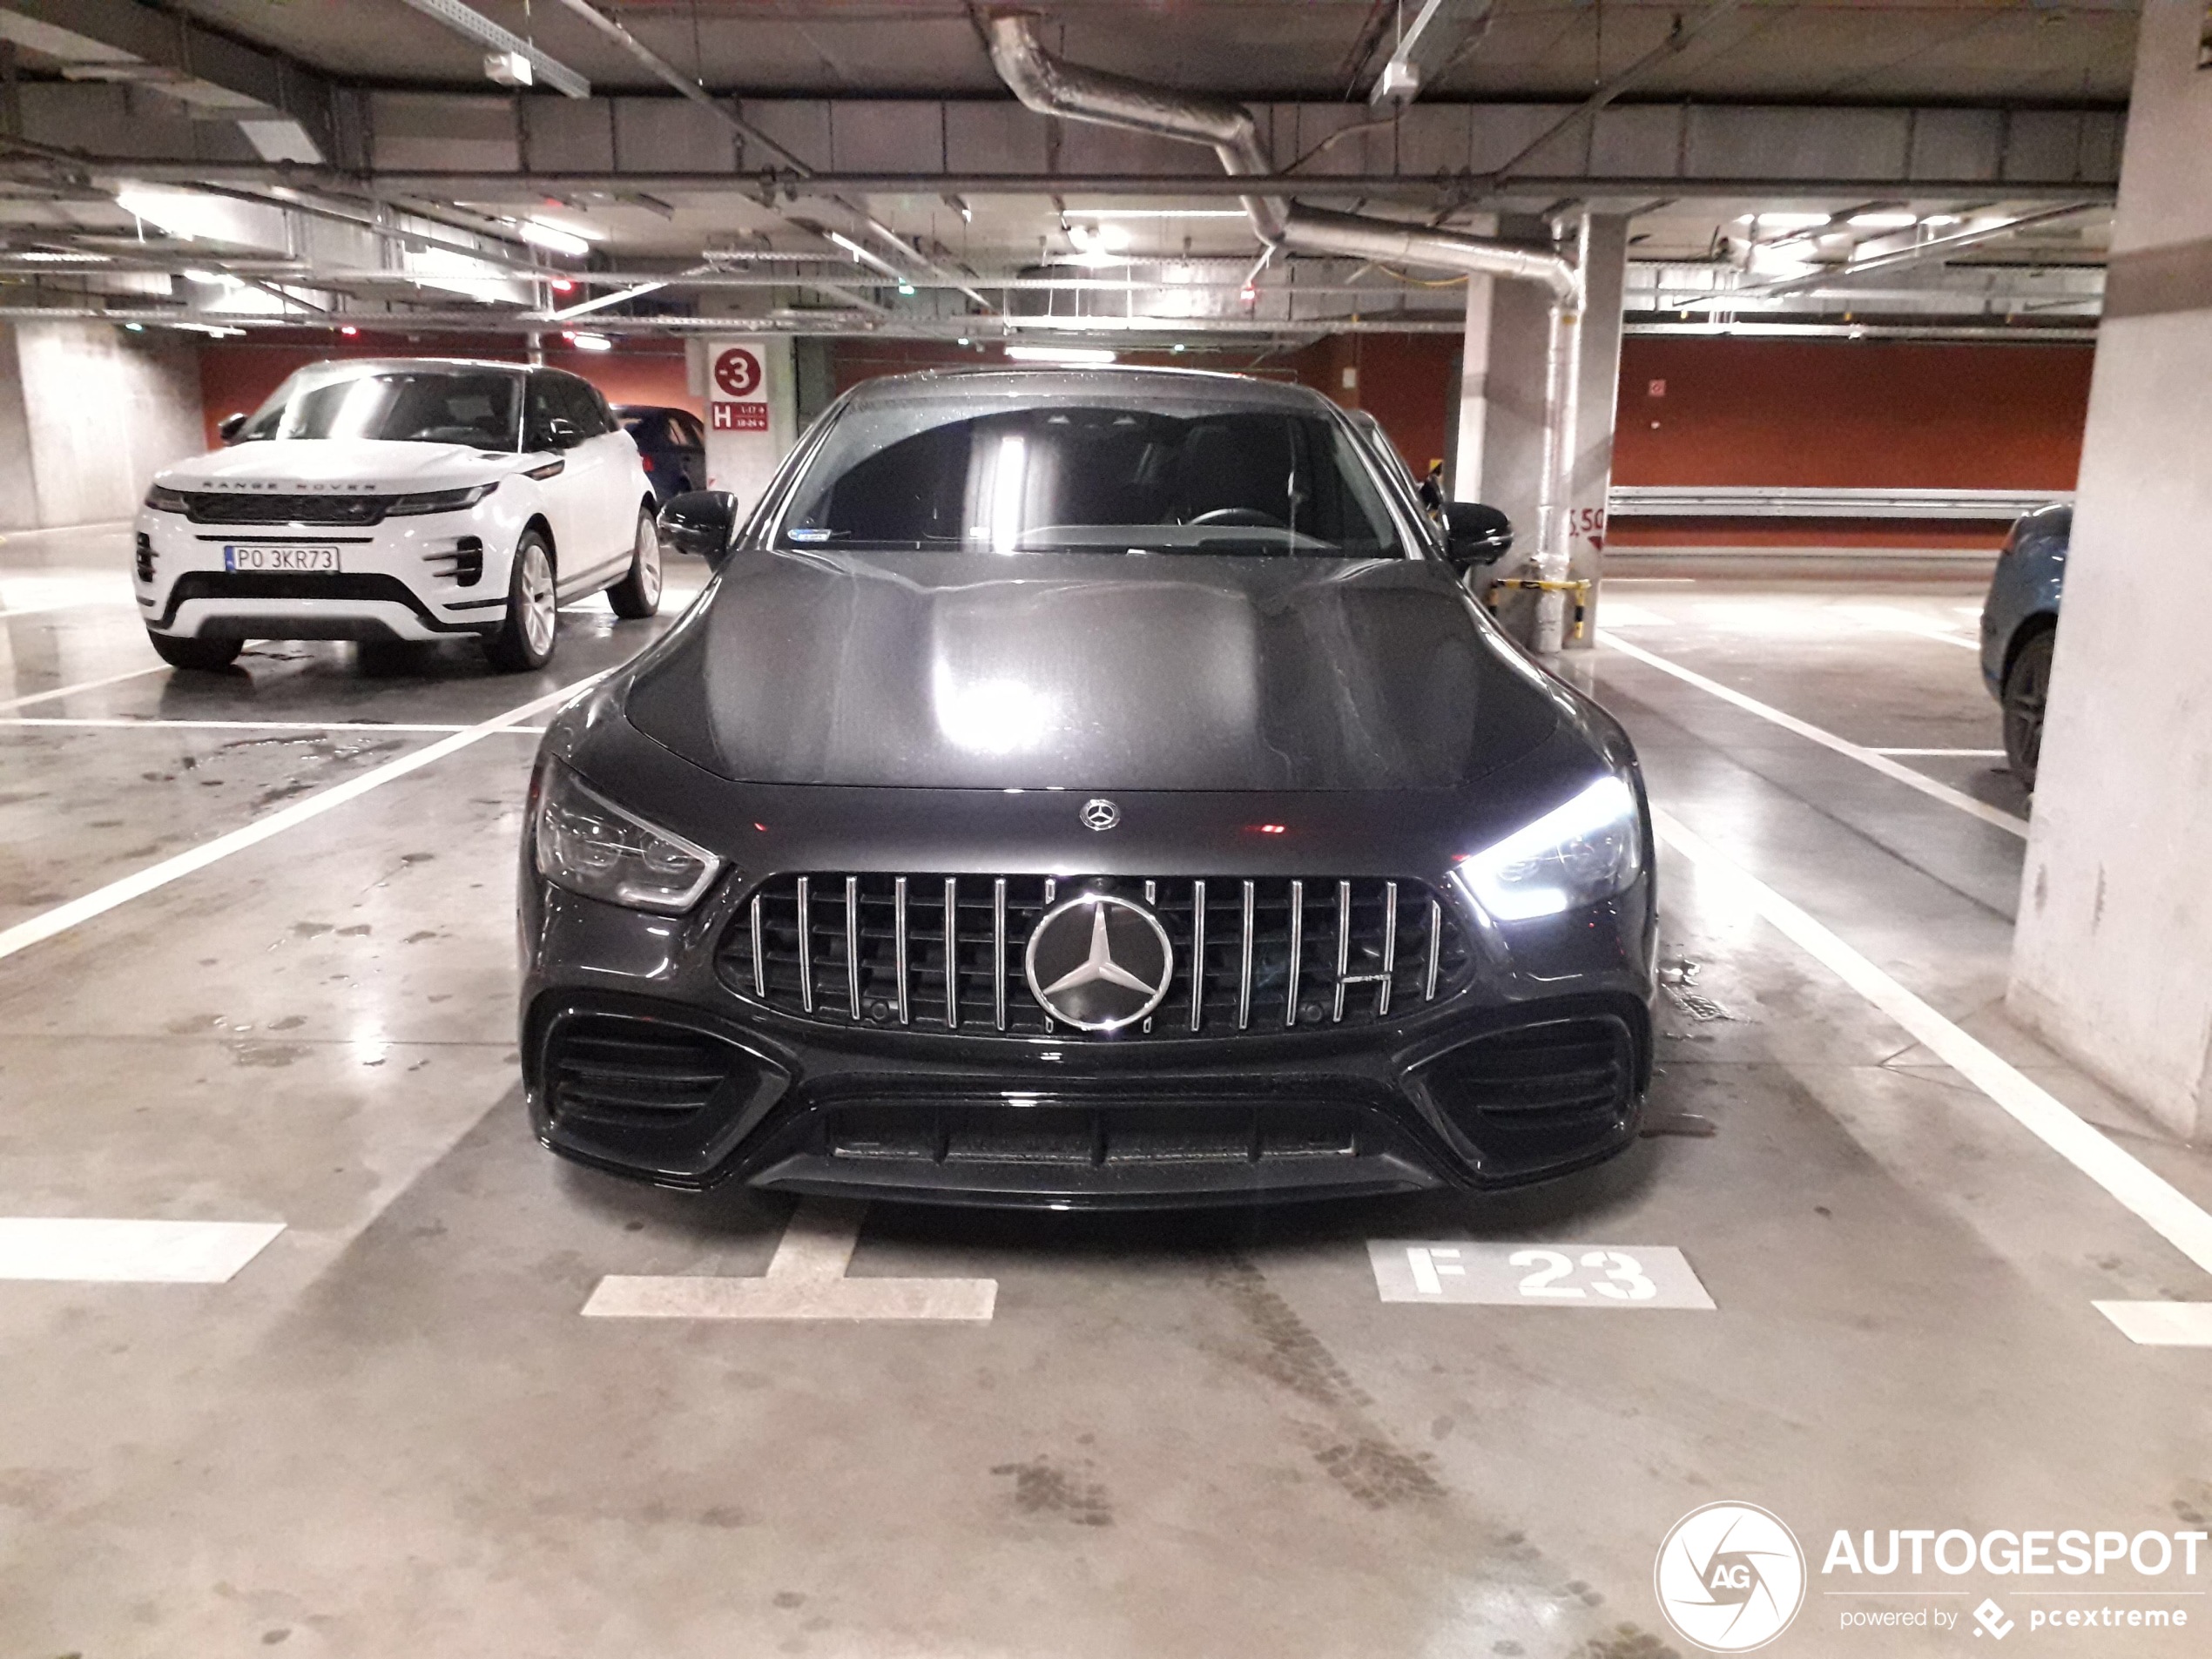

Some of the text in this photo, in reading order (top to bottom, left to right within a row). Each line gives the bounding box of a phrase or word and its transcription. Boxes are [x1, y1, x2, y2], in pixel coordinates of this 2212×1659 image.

[718, 357, 750, 389] -3
[714, 405, 732, 428] H
[202, 481, 278, 489] RANGE
[238, 550, 332, 569] PO 3KR73
[1406, 1247, 1658, 1300] F 23
